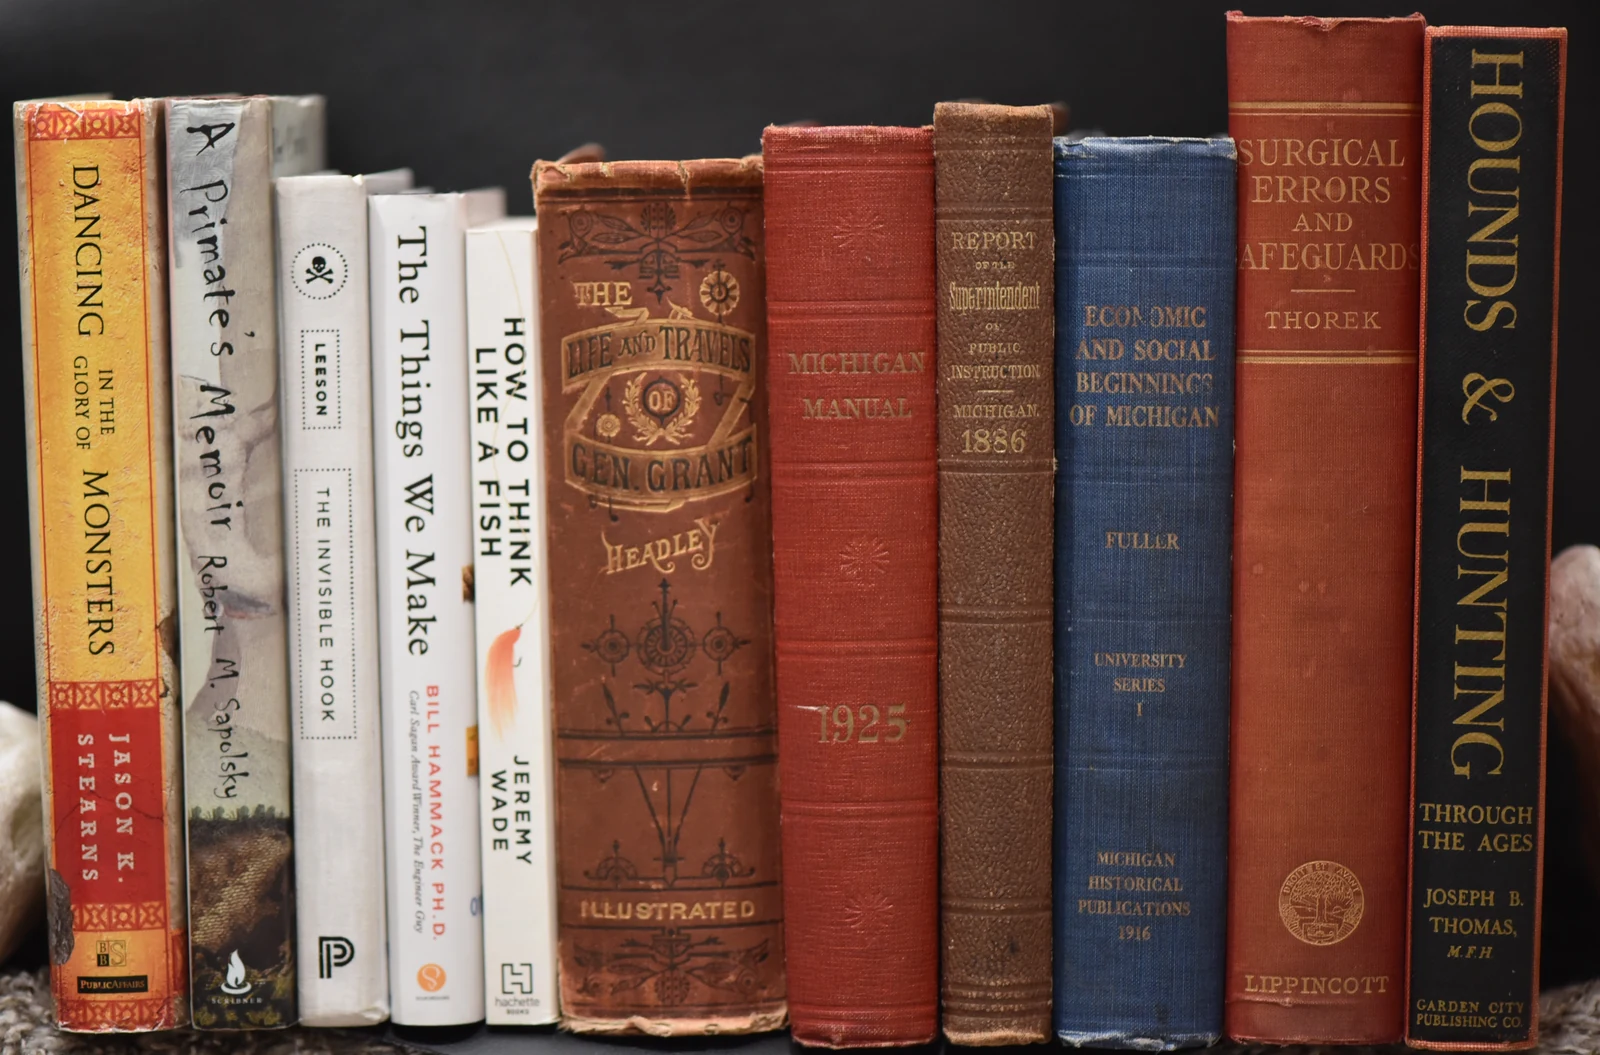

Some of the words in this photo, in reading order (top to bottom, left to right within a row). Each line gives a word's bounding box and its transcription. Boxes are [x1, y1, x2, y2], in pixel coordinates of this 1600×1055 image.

[186, 122, 236, 155] A
[1238, 138, 1405, 167] SURGICAL
[1251, 176, 1391, 203] ERRORS
[1463, 48, 1524, 332] HOUNDS
[1292, 212, 1353, 233] AND
[72, 165, 105, 337] DANCING
[951, 231, 1036, 250] REPORT
[1238, 242, 1419, 271] AFEGUARDS
[180, 179, 255, 357] Primate's
[397, 225, 428, 305] The
[975, 261, 989, 269] OF
[573, 282, 632, 306] THE
[949, 281, 1040, 315] Superintendent
[1265, 311, 1381, 329] THOREK
[503, 317, 527, 401] HOW
[567, 331, 613, 379] LIFE
[617, 331, 656, 356] AND
[659, 325, 752, 373] TRAVELS
[788, 352, 925, 374] MICHIGAN
[968, 342, 1020, 354] PUBLIC
[1075, 338, 1125, 360] AND
[1134, 339, 1216, 361] SOCIAL
[98, 370, 114, 391] IN
[314, 343, 328, 416] LEESON
[476, 348, 498, 423] LIKE
[951, 365, 1040, 378] INSTRUCTION
[73, 356, 90, 420] GLORY
[395, 319, 431, 459] Things
[649, 389, 674, 411] OF
[1462, 372, 1515, 423] &
[99, 397, 116, 435] THE
[803, 399, 912, 420] MANUAL
[1070, 405, 1097, 426] OF
[1105, 404, 1219, 427] MICHIGAN
[76, 426, 91, 449] OF
[478, 441, 498, 461] A
[506, 418, 529, 462] TO
[961, 429, 1027, 453] 1886
[193, 385, 243, 532] Memoir
[571, 442, 640, 491] GEN.
[647, 436, 754, 491] GRANT
[317, 487, 331, 528] THE
[404, 473, 434, 533] We
[479, 481, 501, 556] FISH
[508, 479, 532, 586] THINK
[601, 517, 720, 575] HEADLEY
[82, 470, 116, 656] MONSTERS
[197, 554, 228, 635] Robert
[317, 539, 334, 649] INVISIBLE
[406, 551, 437, 657] Make
[1450, 466, 1512, 780] HUNTING
[209, 657, 239, 688] M.
[1094, 653, 1187, 668] UNIVERSITY
[320, 660, 335, 722] HOOK
[1113, 677, 1165, 692] SERIES
[409, 690, 420, 717] Carl
[426, 685, 439, 734] BILL
[409, 719, 421, 753] Sagan
[818, 703, 908, 743] 1925
[213, 699, 250, 799] Sapolsky
[109, 734, 134, 836] JASON
[411, 754, 421, 791] Award
[78, 734, 99, 881] STEARNS
[412, 792, 422, 834] Winner,
[428, 745, 444, 870] HAMMACK
[491, 770, 508, 851] WADE
[514, 755, 532, 865] JEREMY
[1420, 803, 1532, 826] THROUGH
[414, 837, 423, 857] The
[1419, 830, 1464, 851] THE
[1478, 831, 1533, 852] AGES
[117, 853, 135, 882] K.
[1097, 851, 1175, 867] MICHIGAN
[412, 859, 425, 908] Engineer
[1088, 876, 1183, 892] HISTORICAL
[1283, 868, 1306, 893] DROIT
[1337, 868, 1360, 892] AVANT
[580, 902, 755, 920] ILLUSTRATED
[1078, 899, 1191, 916] PUBLICATIONS
[1423, 889, 1494, 909] JOSEPH
[1508, 889, 1524, 906] B.
[413, 910, 426, 934] Guy
[1119, 926, 1151, 940] 1916
[1429, 917, 1517, 937] THOMAS,
[1245, 974, 1389, 994] LIPPINCOTT
[495, 997, 539, 1006] hachette
[1416, 999, 1479, 1013] GARDEN
[1488, 1001, 1524, 1014] CITY
[1416, 1014, 1498, 1028] PUBLISHING
